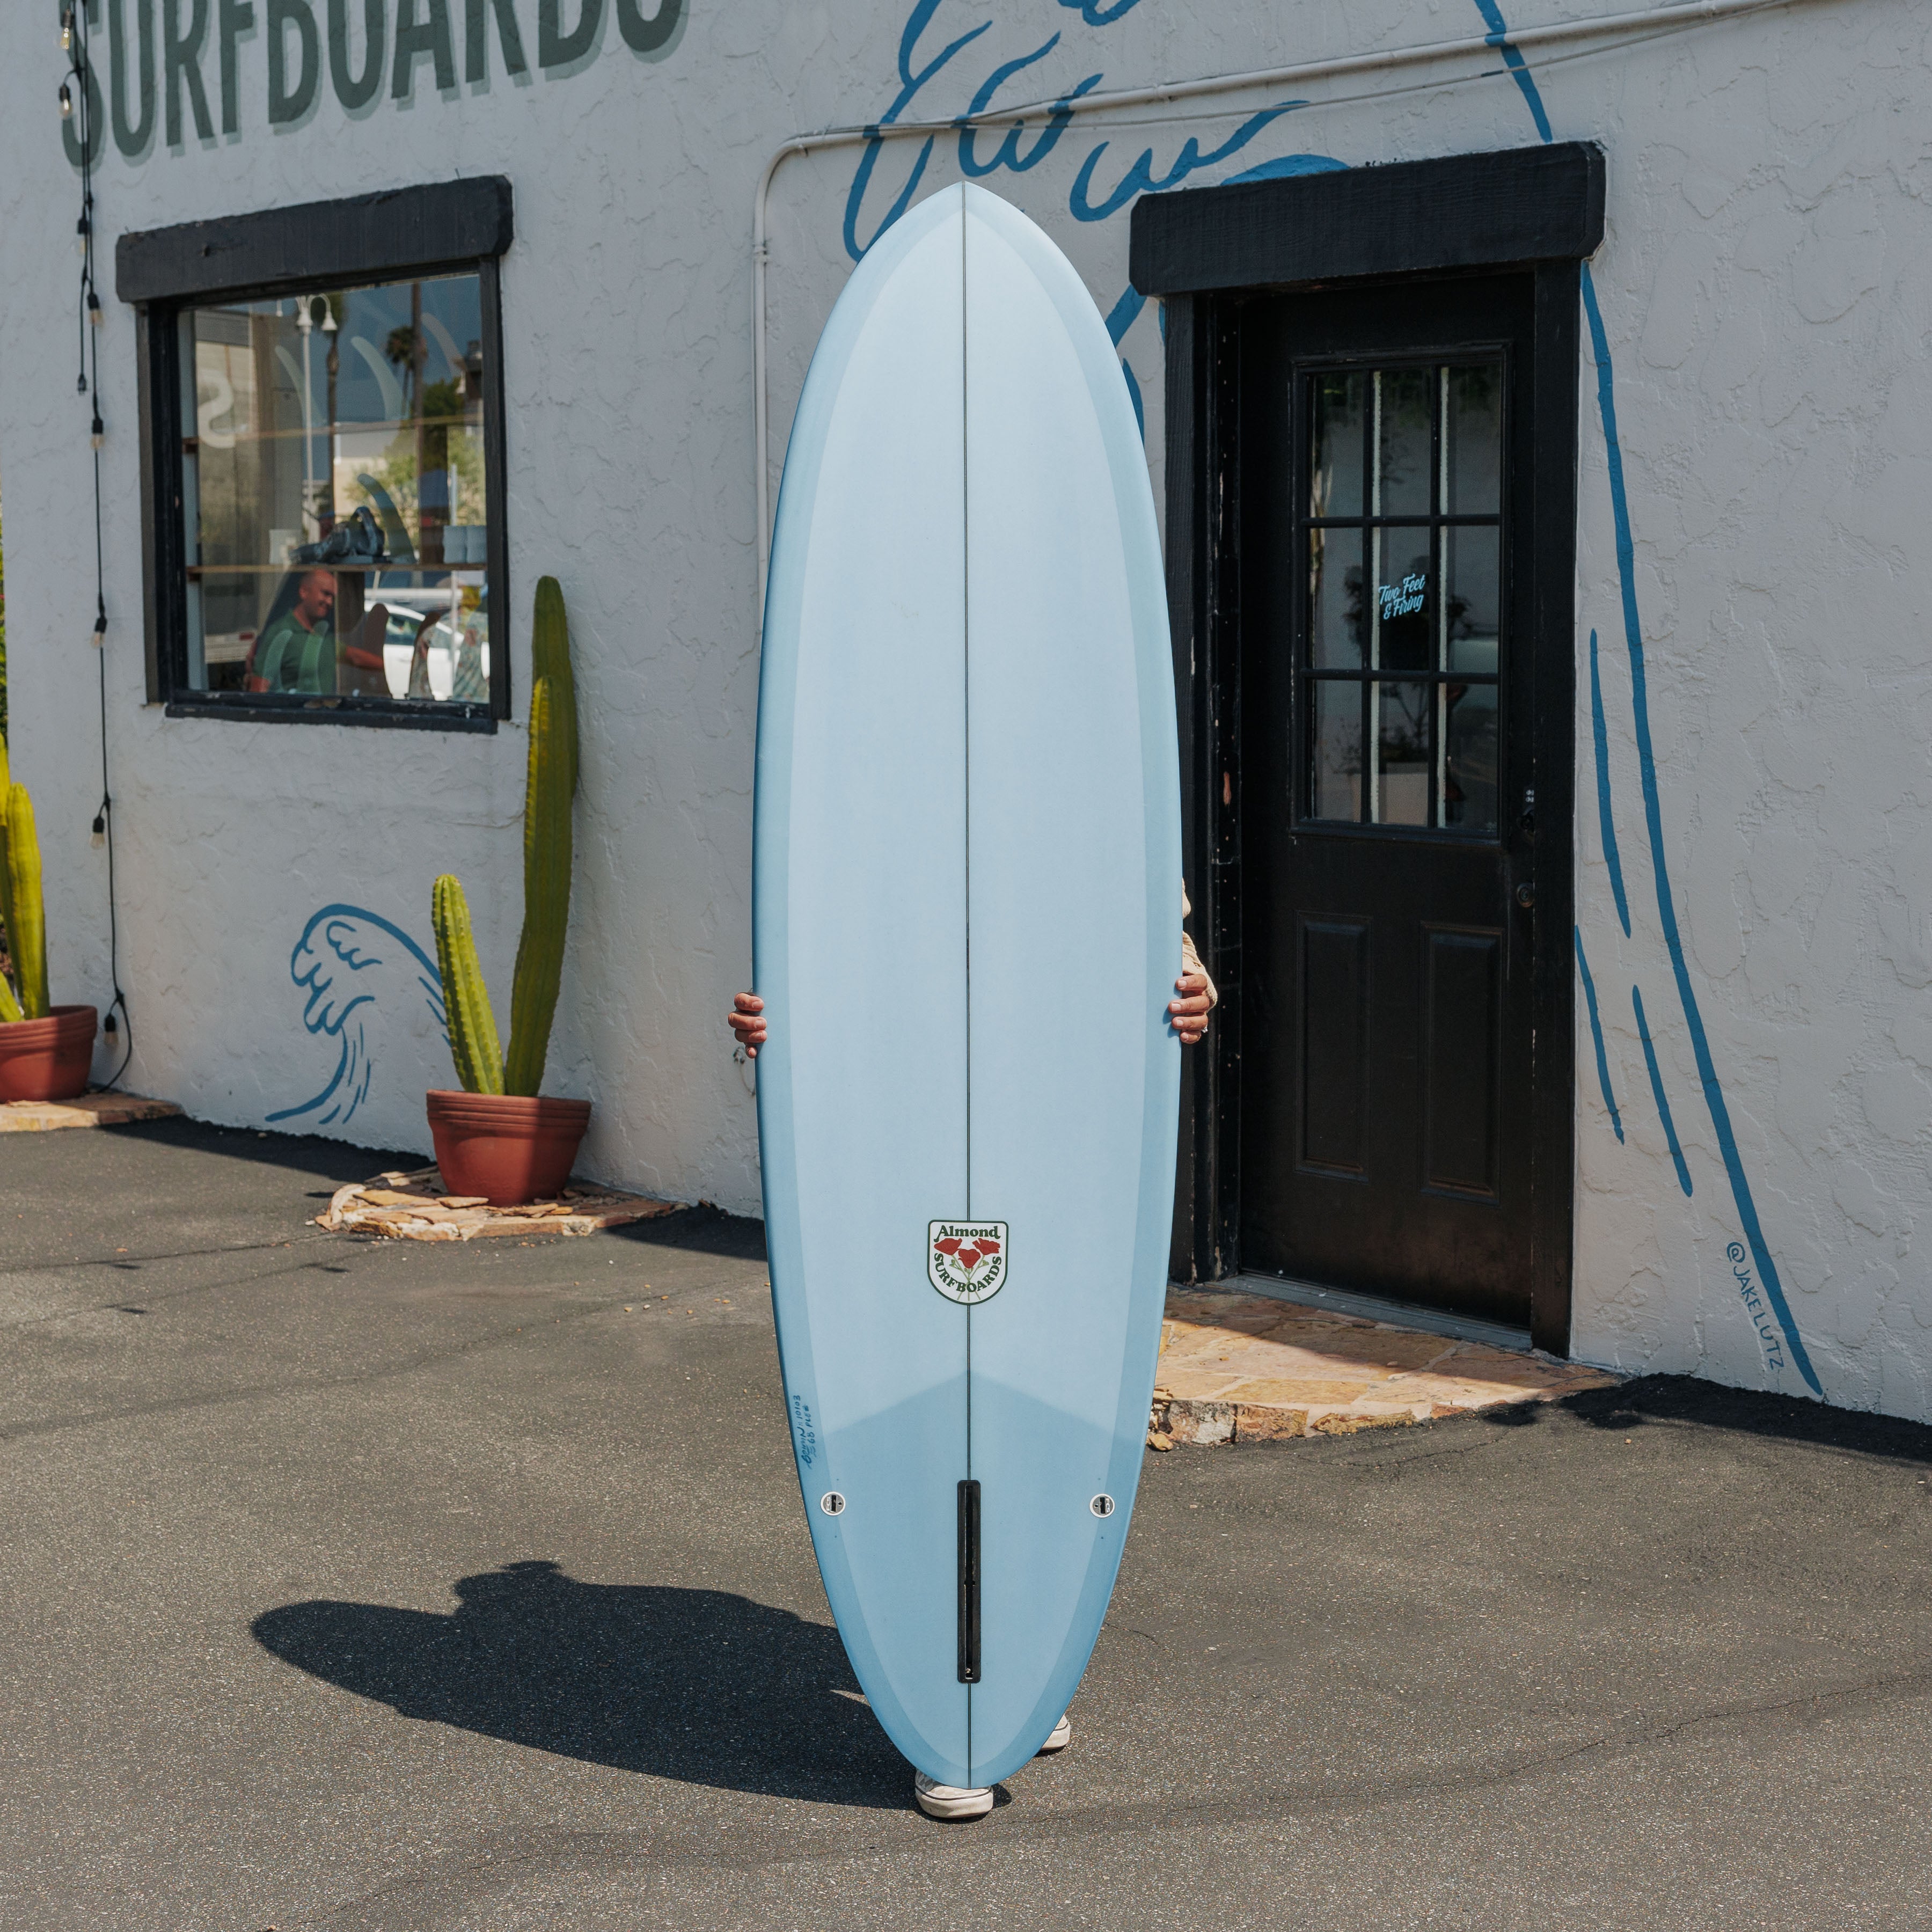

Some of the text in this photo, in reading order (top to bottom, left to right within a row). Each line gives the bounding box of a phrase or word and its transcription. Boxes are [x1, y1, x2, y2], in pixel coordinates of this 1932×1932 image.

[59, 0, 689, 174] SURFB
[1378, 573, 1425, 605] Two Feet
[1384, 594, 1424, 620] & Firing
[933, 1225, 1001, 1242] Almond
[934, 1253, 1002, 1293] SURFBOARDS
[1726, 1241, 1784, 1370] @JAKELUTZ
